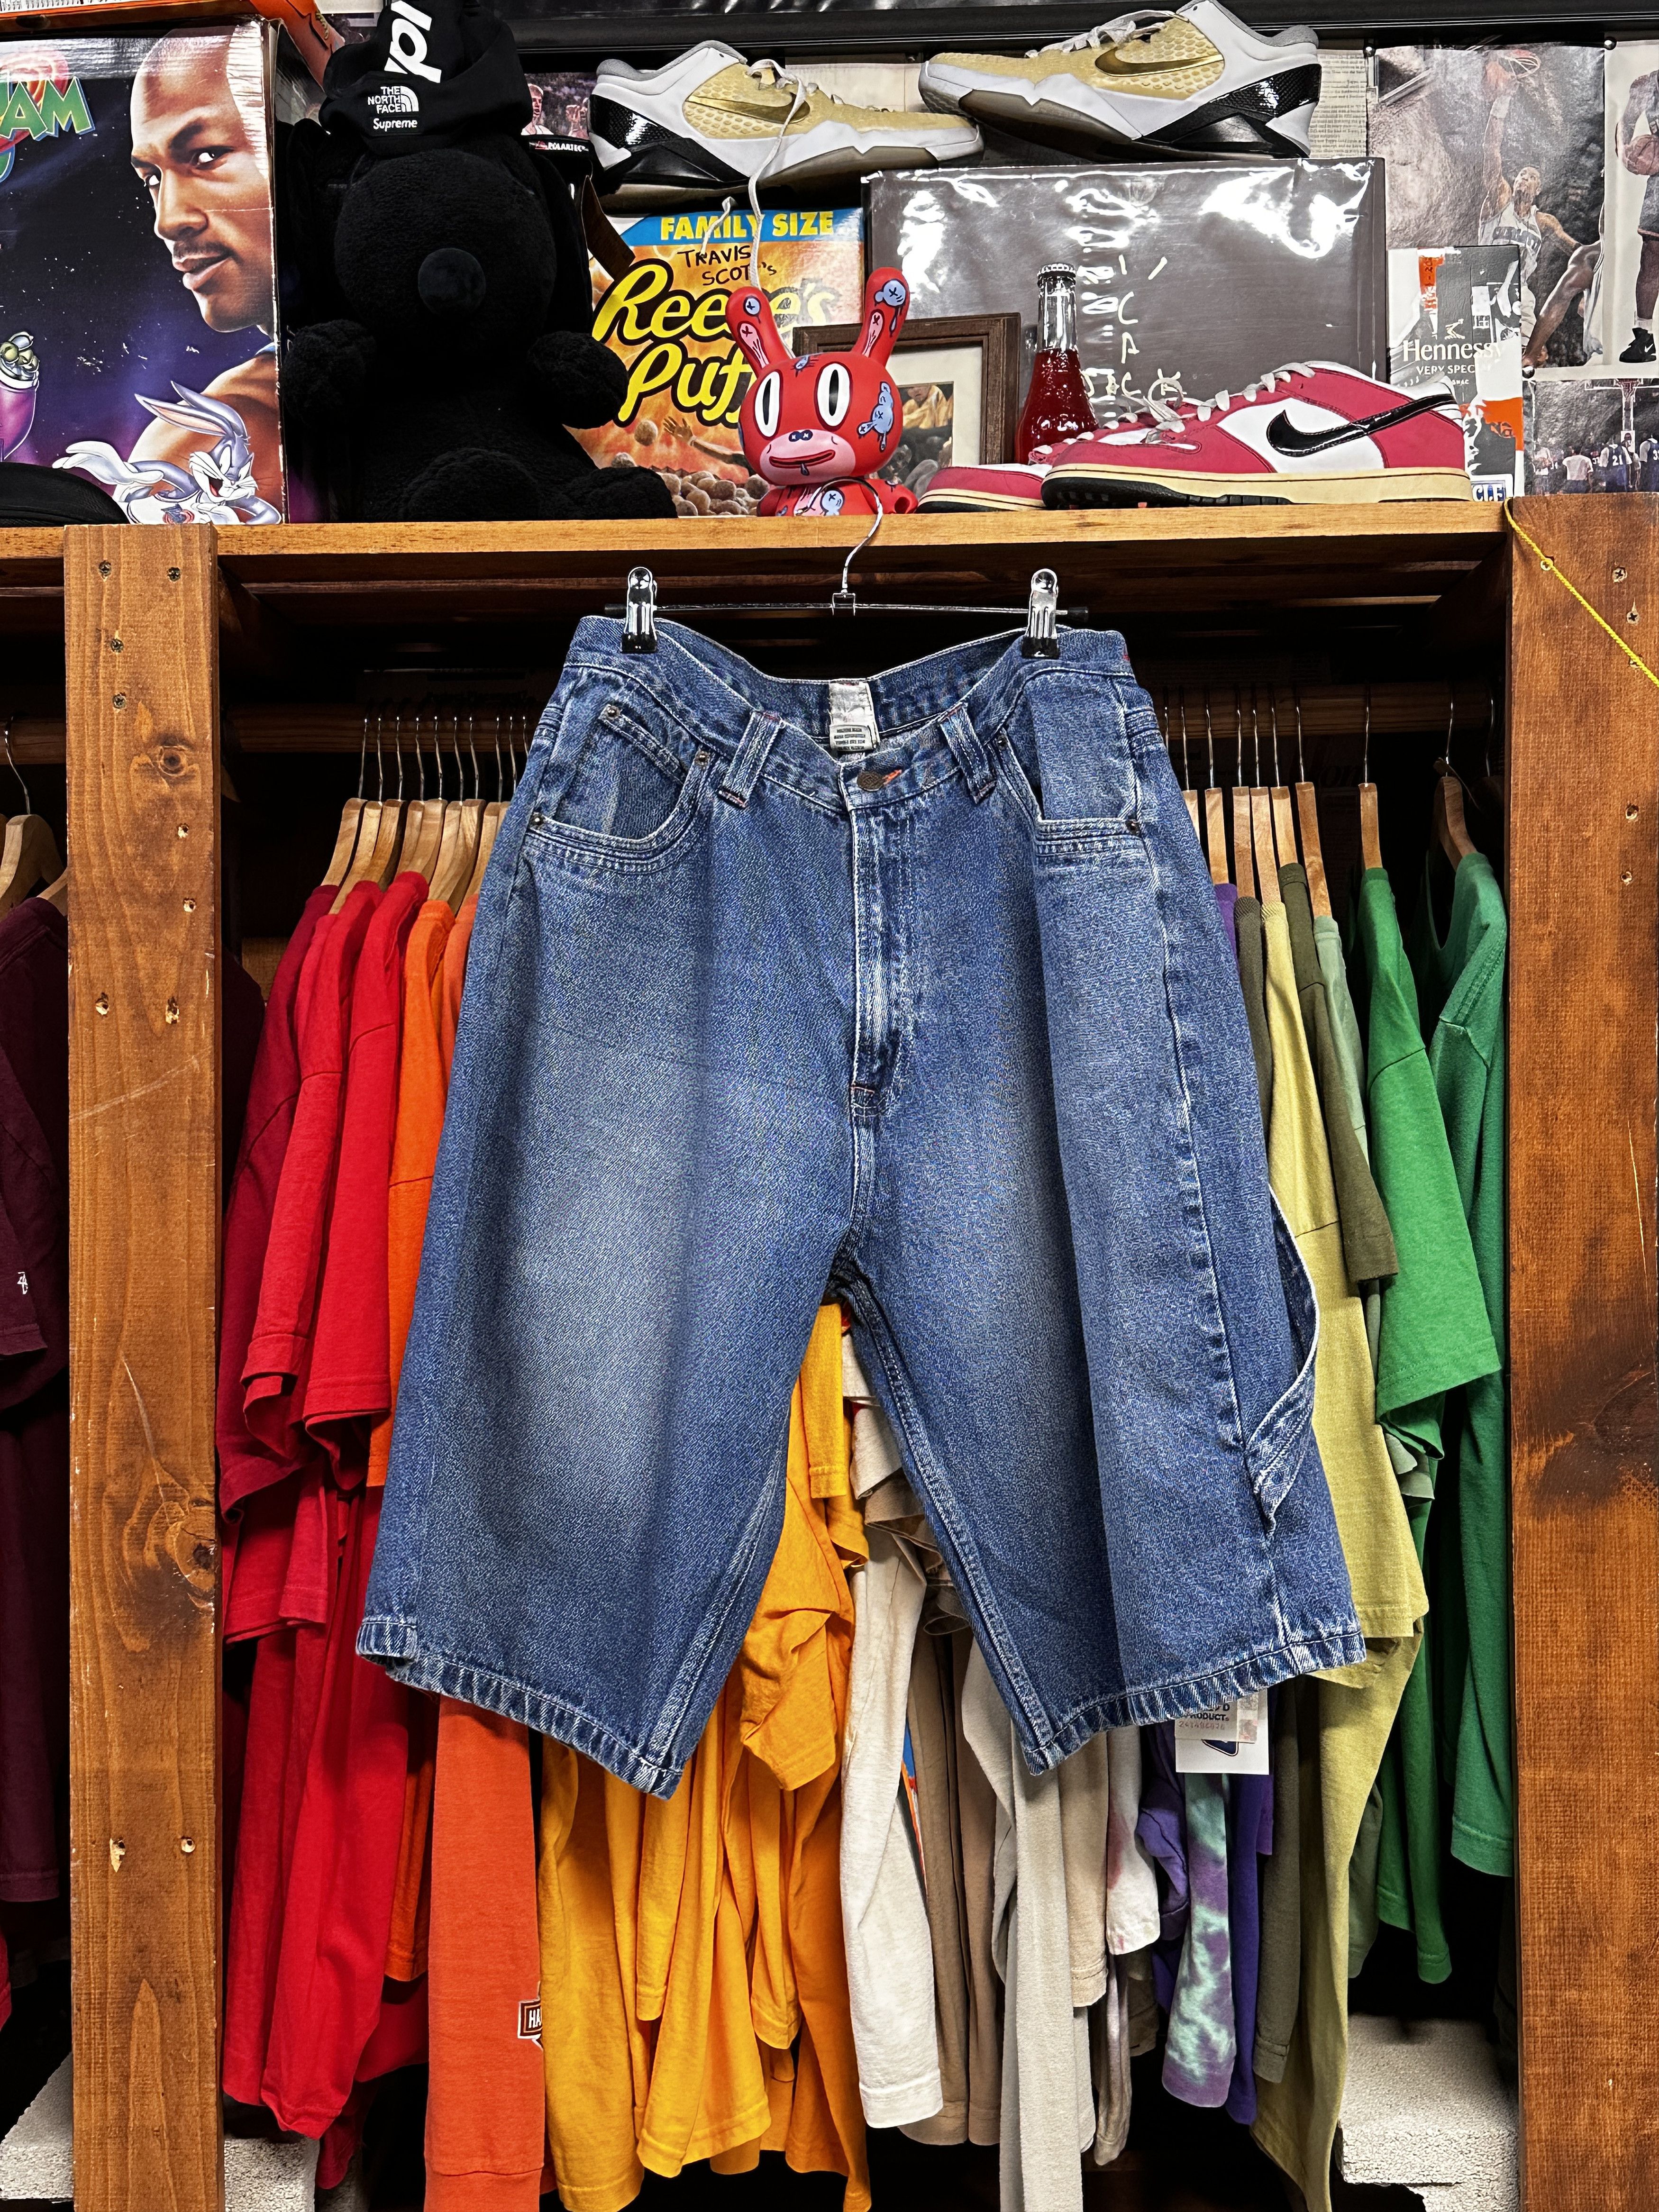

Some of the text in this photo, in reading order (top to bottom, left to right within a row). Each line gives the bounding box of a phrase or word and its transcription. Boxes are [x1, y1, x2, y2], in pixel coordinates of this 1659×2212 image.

[380, 86, 401, 95] THE
[367, 95, 401, 105] NORTH
[0, 73, 95, 156] AM
[376, 103, 401, 114] FACE
[373, 118, 418, 132] Supreme
[661, 211, 834, 240] FAMILY SIZE
[677, 245, 751, 268] TRAVIS
[591, 263, 836, 342] Reee's
[1612, 455, 1623, 466] 21
